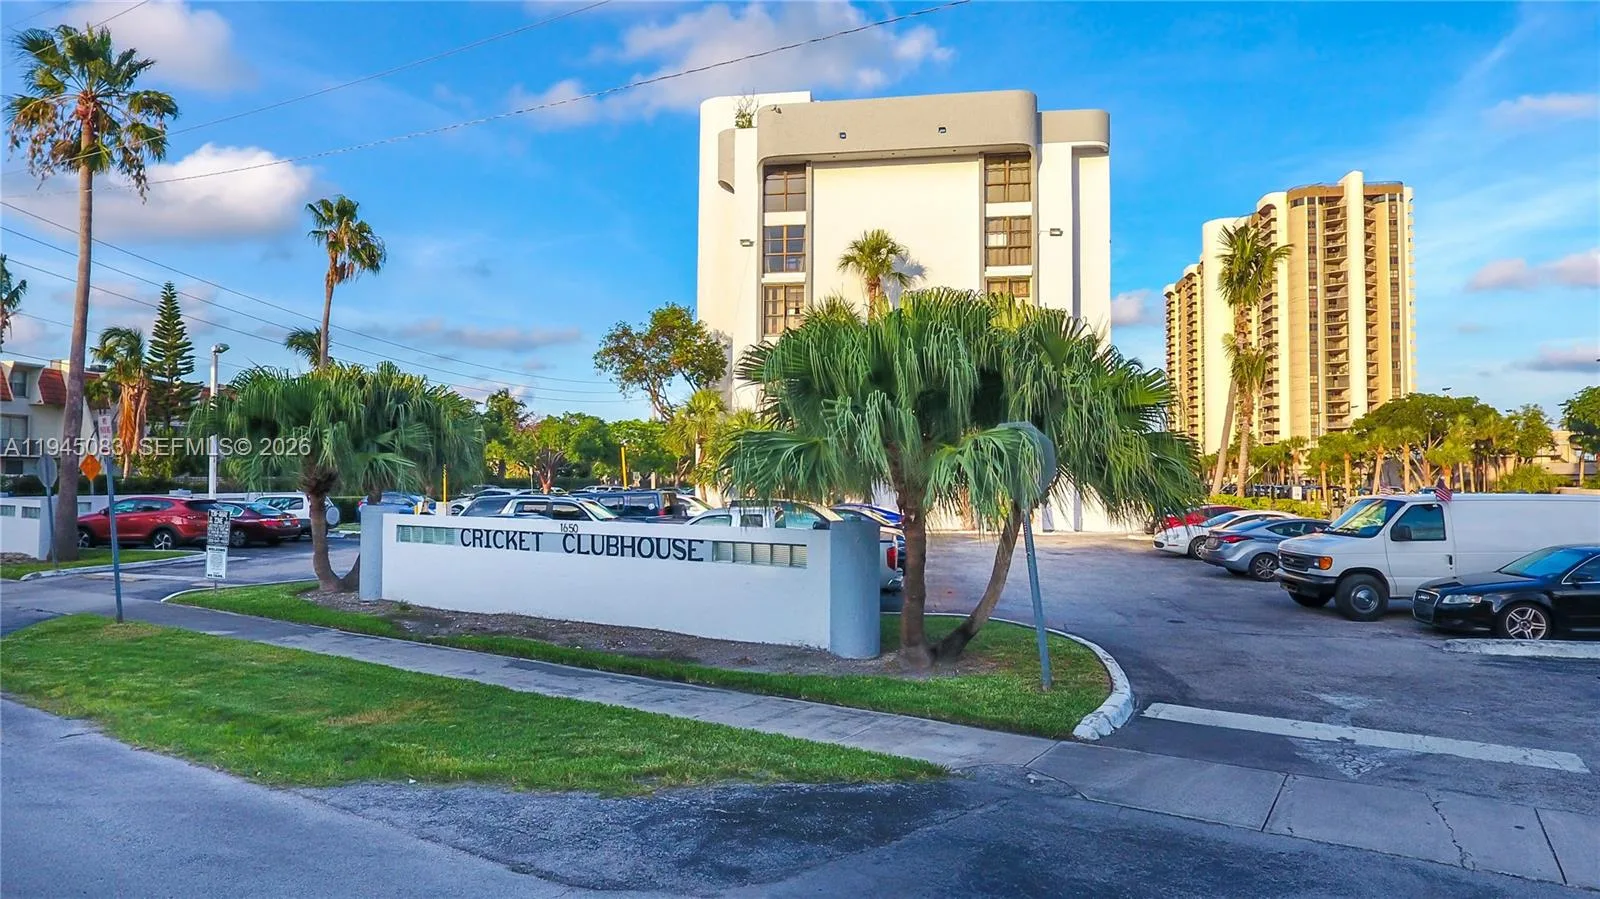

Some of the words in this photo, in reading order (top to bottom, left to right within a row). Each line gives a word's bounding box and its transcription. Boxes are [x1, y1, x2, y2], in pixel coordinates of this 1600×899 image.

[560, 523, 579, 533] 1650
[460, 528, 544, 552] CRICKET
[562, 533, 704, 562] CLUBHOUSE
